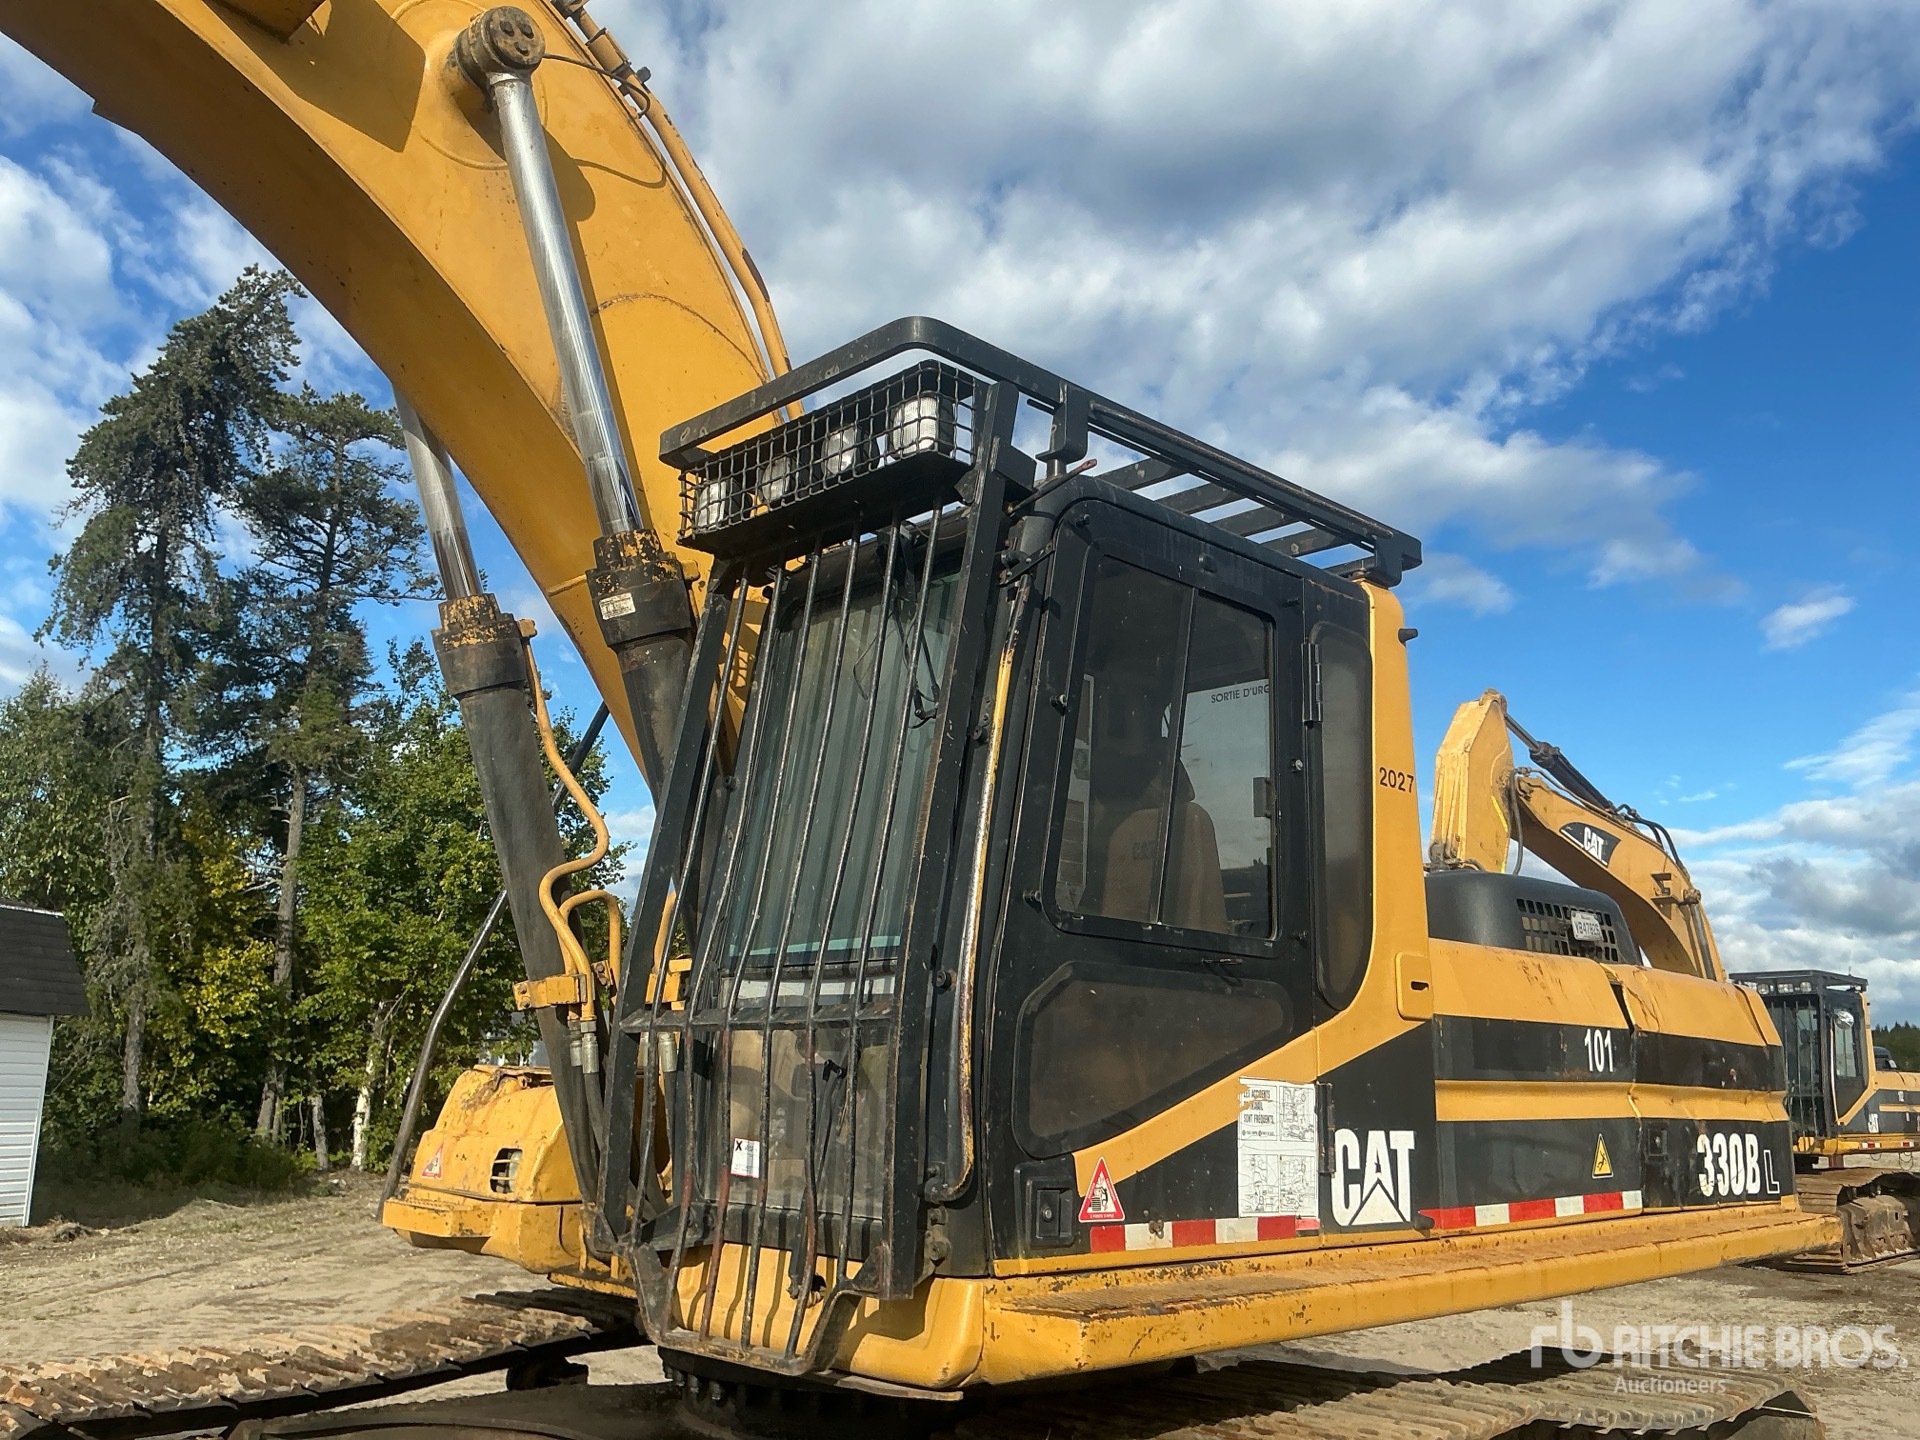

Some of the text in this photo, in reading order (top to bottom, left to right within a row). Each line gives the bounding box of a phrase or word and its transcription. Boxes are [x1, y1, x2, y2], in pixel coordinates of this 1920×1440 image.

[1210, 689, 1240, 704] SORTIE
[1379, 766, 1415, 794] 2027
[1583, 826, 1605, 861] CAT
[1584, 1028, 1614, 1072] 101
[735, 1140, 743, 1152] X
[1331, 1128, 1415, 1226] CAT
[1696, 1132, 1761, 1197] 330B
